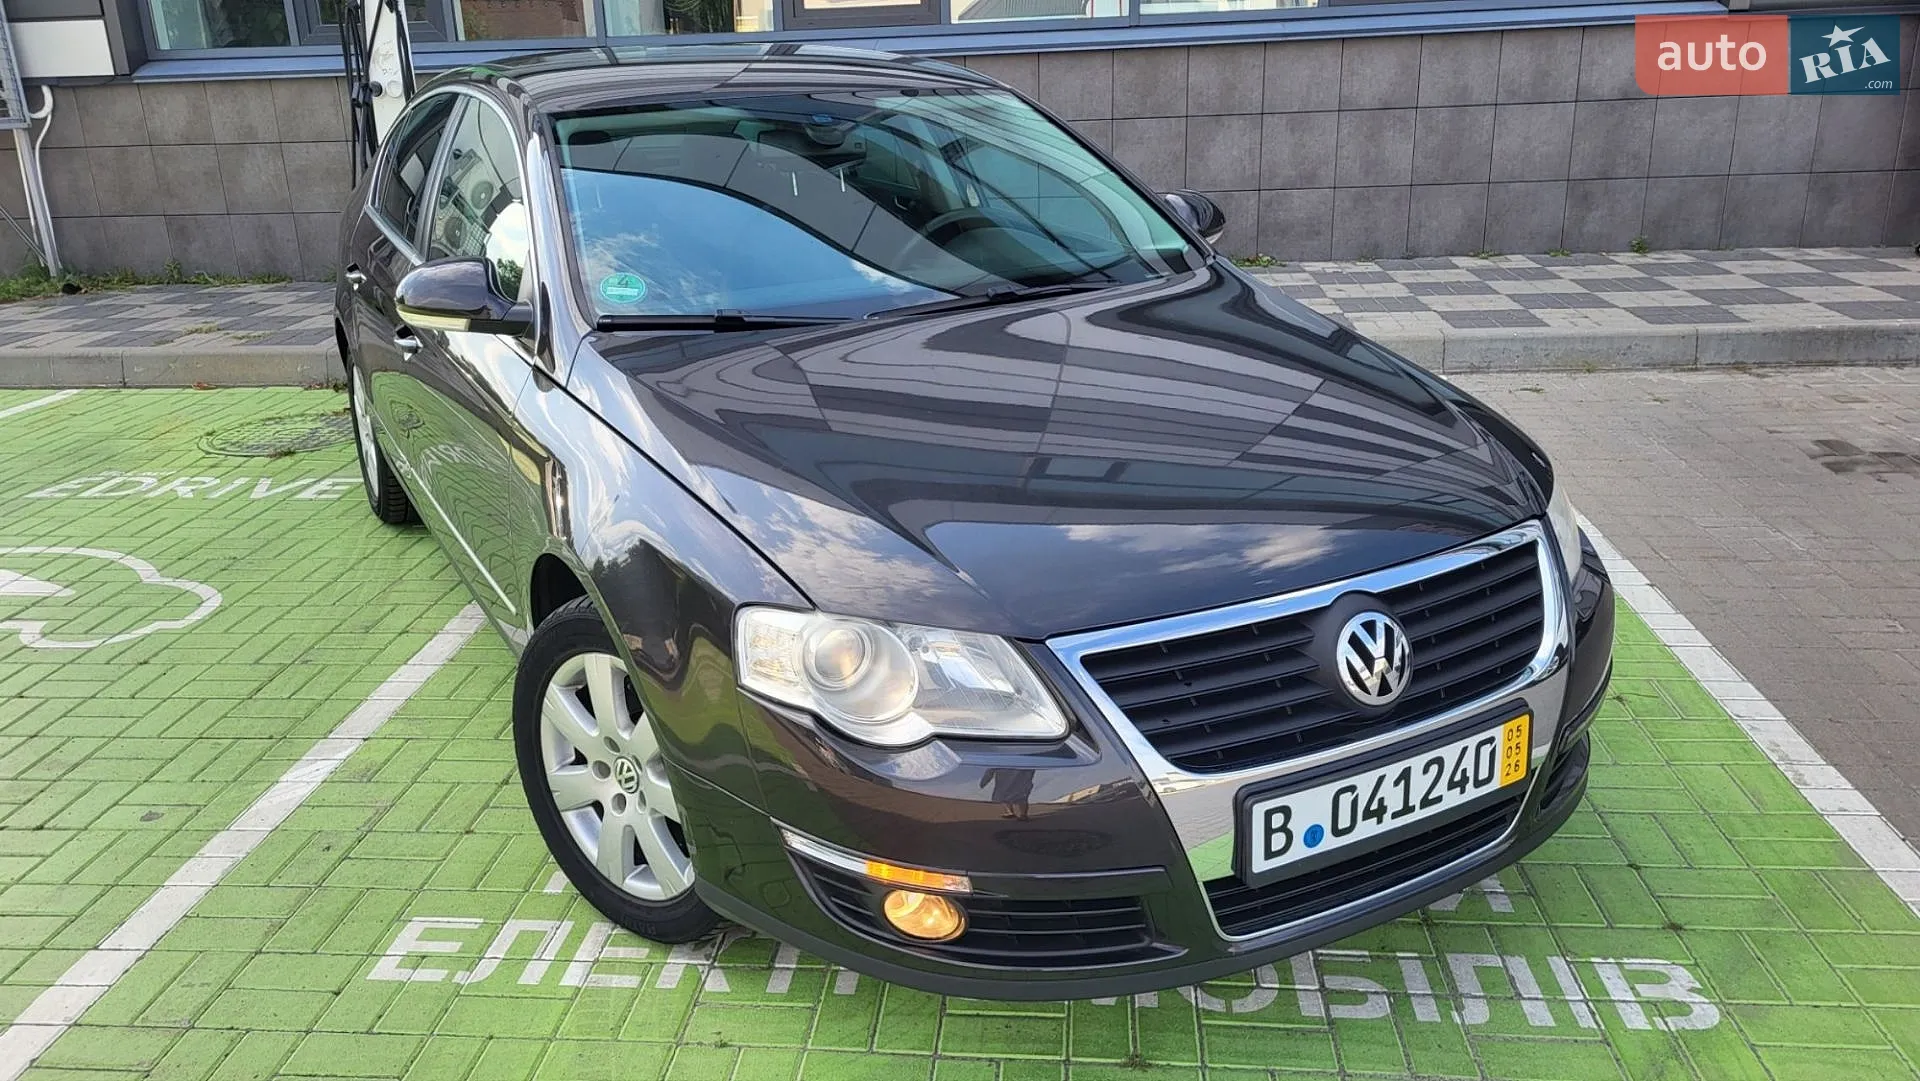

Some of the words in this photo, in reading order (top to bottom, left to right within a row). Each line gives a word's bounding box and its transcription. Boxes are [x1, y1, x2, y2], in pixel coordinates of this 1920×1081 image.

[1507, 724, 1522, 742] 05
[1506, 742, 1521, 759] 05
[1505, 759, 1520, 777] 26
[1263, 804, 1294, 861] B
[1330, 735, 1497, 838] 041240
